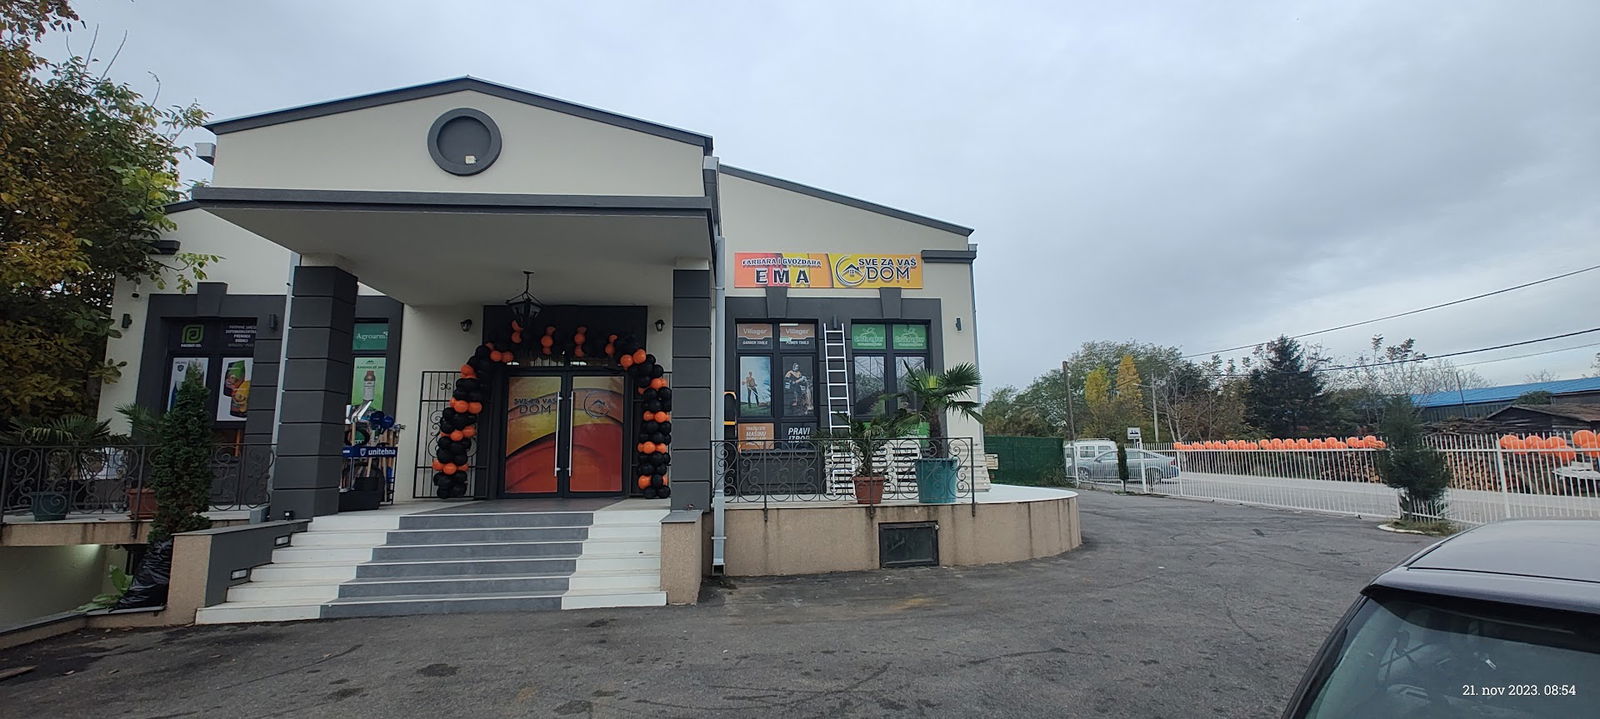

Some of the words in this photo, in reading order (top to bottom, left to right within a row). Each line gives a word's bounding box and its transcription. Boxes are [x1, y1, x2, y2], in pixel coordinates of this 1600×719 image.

[858, 258, 878, 266] SVE
[880, 258, 894, 266] ZA
[896, 256, 917, 266] VAŠ
[866, 266, 910, 280] DOM
[519, 404, 551, 414] DOM
[787, 427, 811, 436] PRAVI
[368, 447, 396, 456] unitehna
